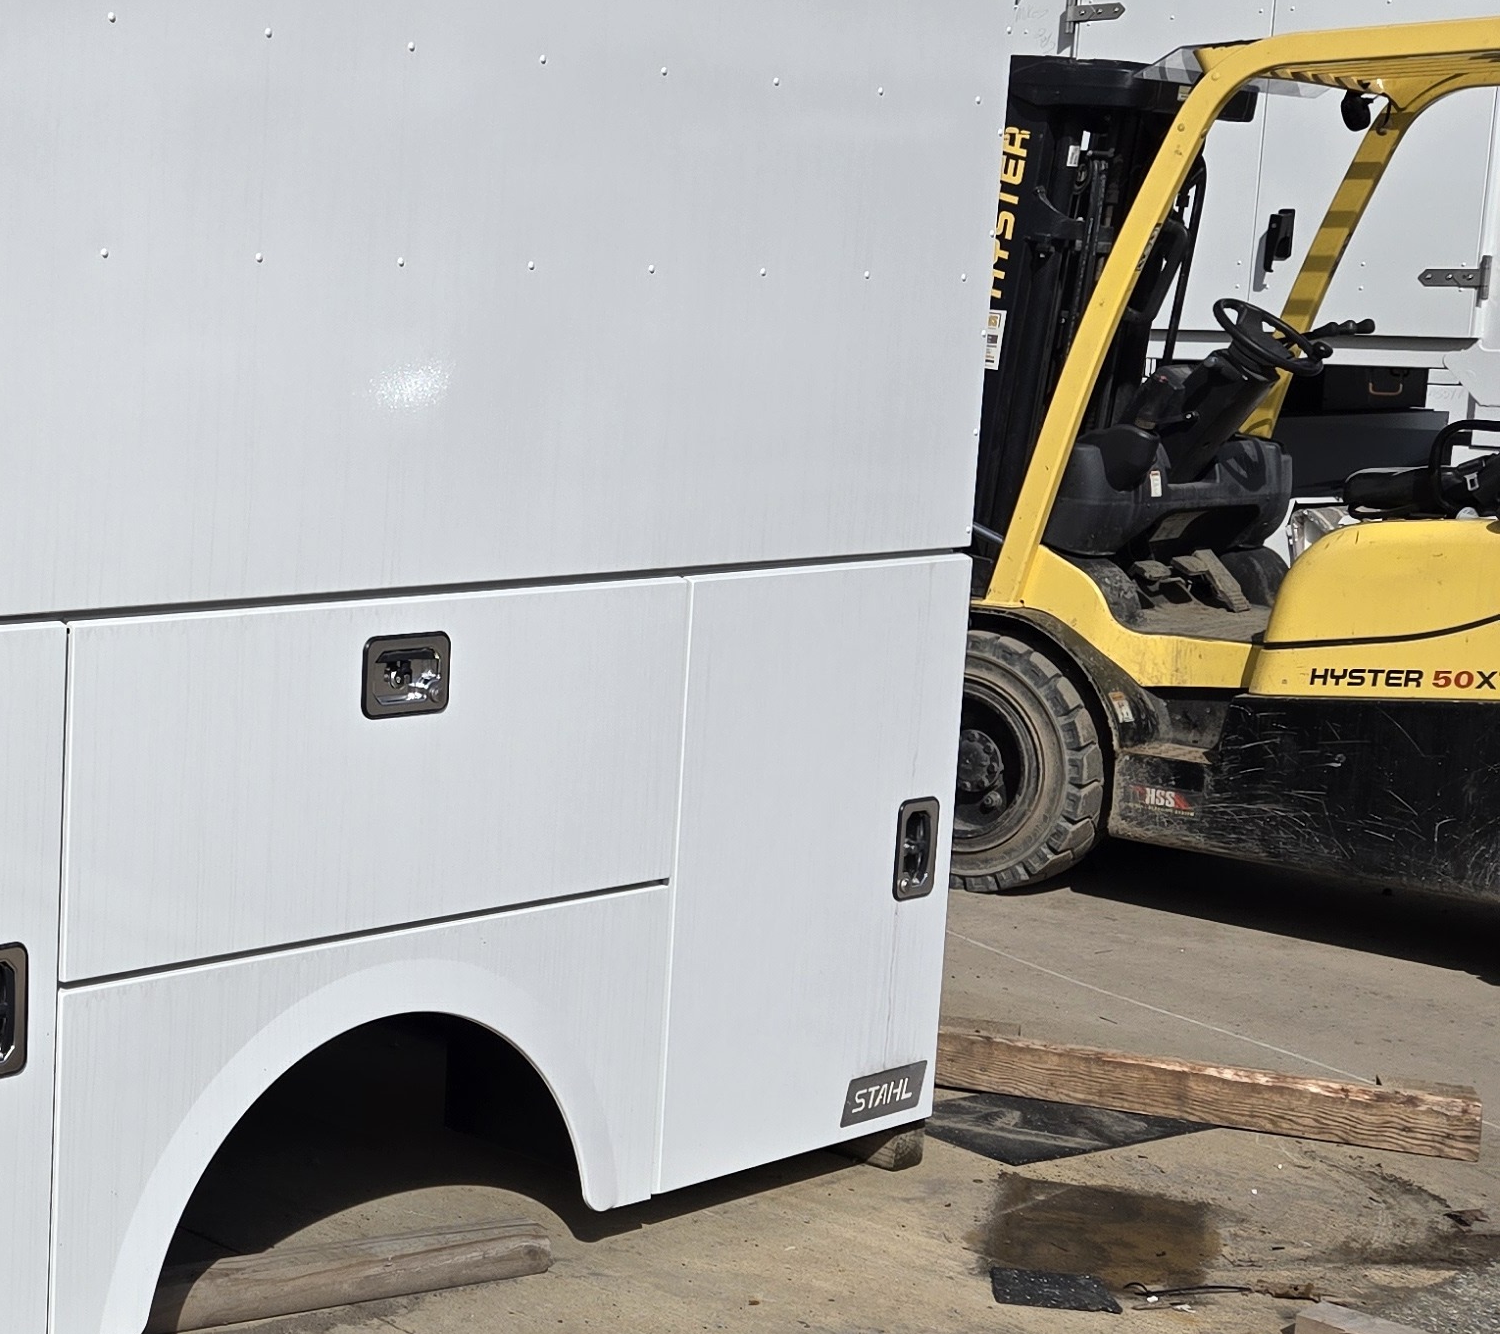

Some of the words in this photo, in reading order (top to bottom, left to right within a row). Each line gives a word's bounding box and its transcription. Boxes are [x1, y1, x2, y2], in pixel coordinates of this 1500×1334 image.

[1309, 668, 1424, 688] HYSTER
[1431, 670, 1500, 690] 50X
[1145, 787, 1176, 807] HSS
[851, 1077, 913, 1114] STAHL
